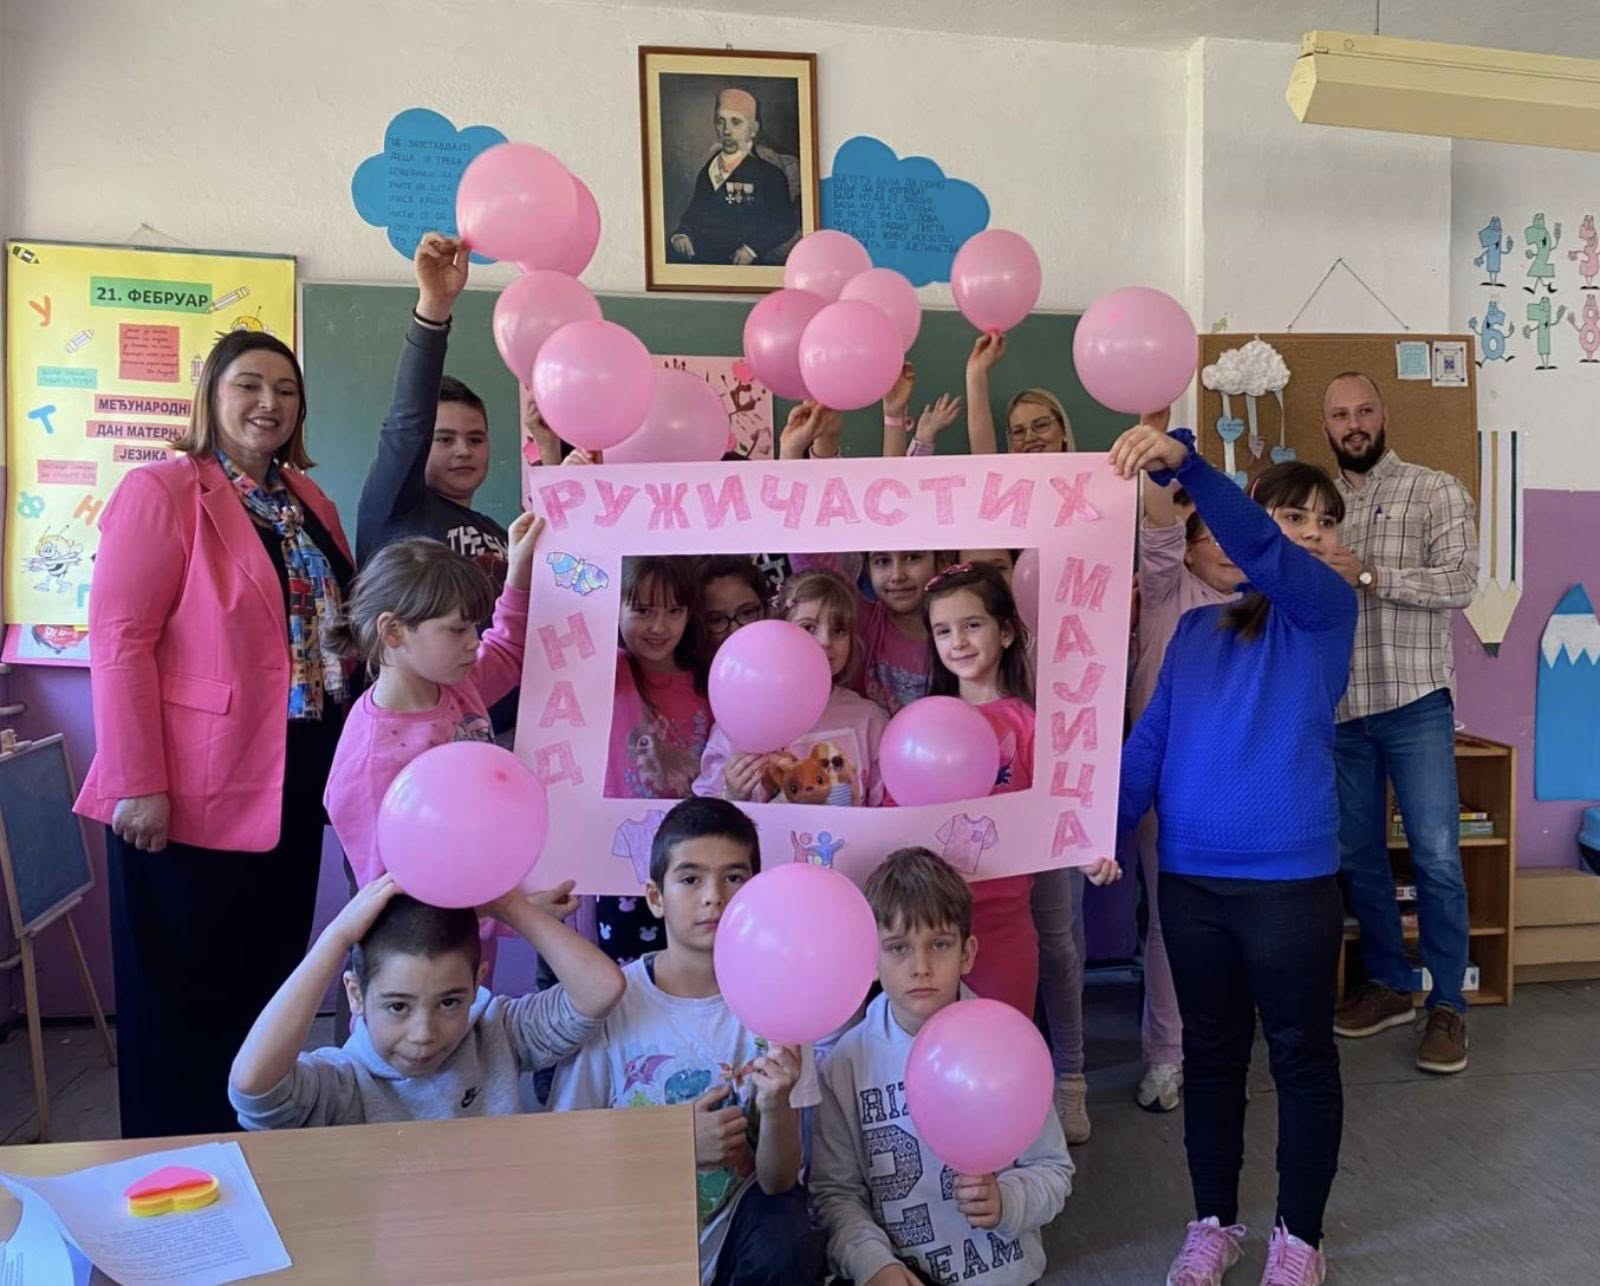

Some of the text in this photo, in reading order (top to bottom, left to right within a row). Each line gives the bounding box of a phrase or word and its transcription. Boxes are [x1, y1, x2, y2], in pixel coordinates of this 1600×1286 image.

[96, 286, 209, 308] 21. ФЕБРУАР
[95, 423, 124, 438] ДАН
[119, 448, 168, 461] ЈЕЗИКА
[538, 471, 1100, 531] РУЖИЧАСТИХ
[1050, 556, 1112, 858] МАЈИЦА
